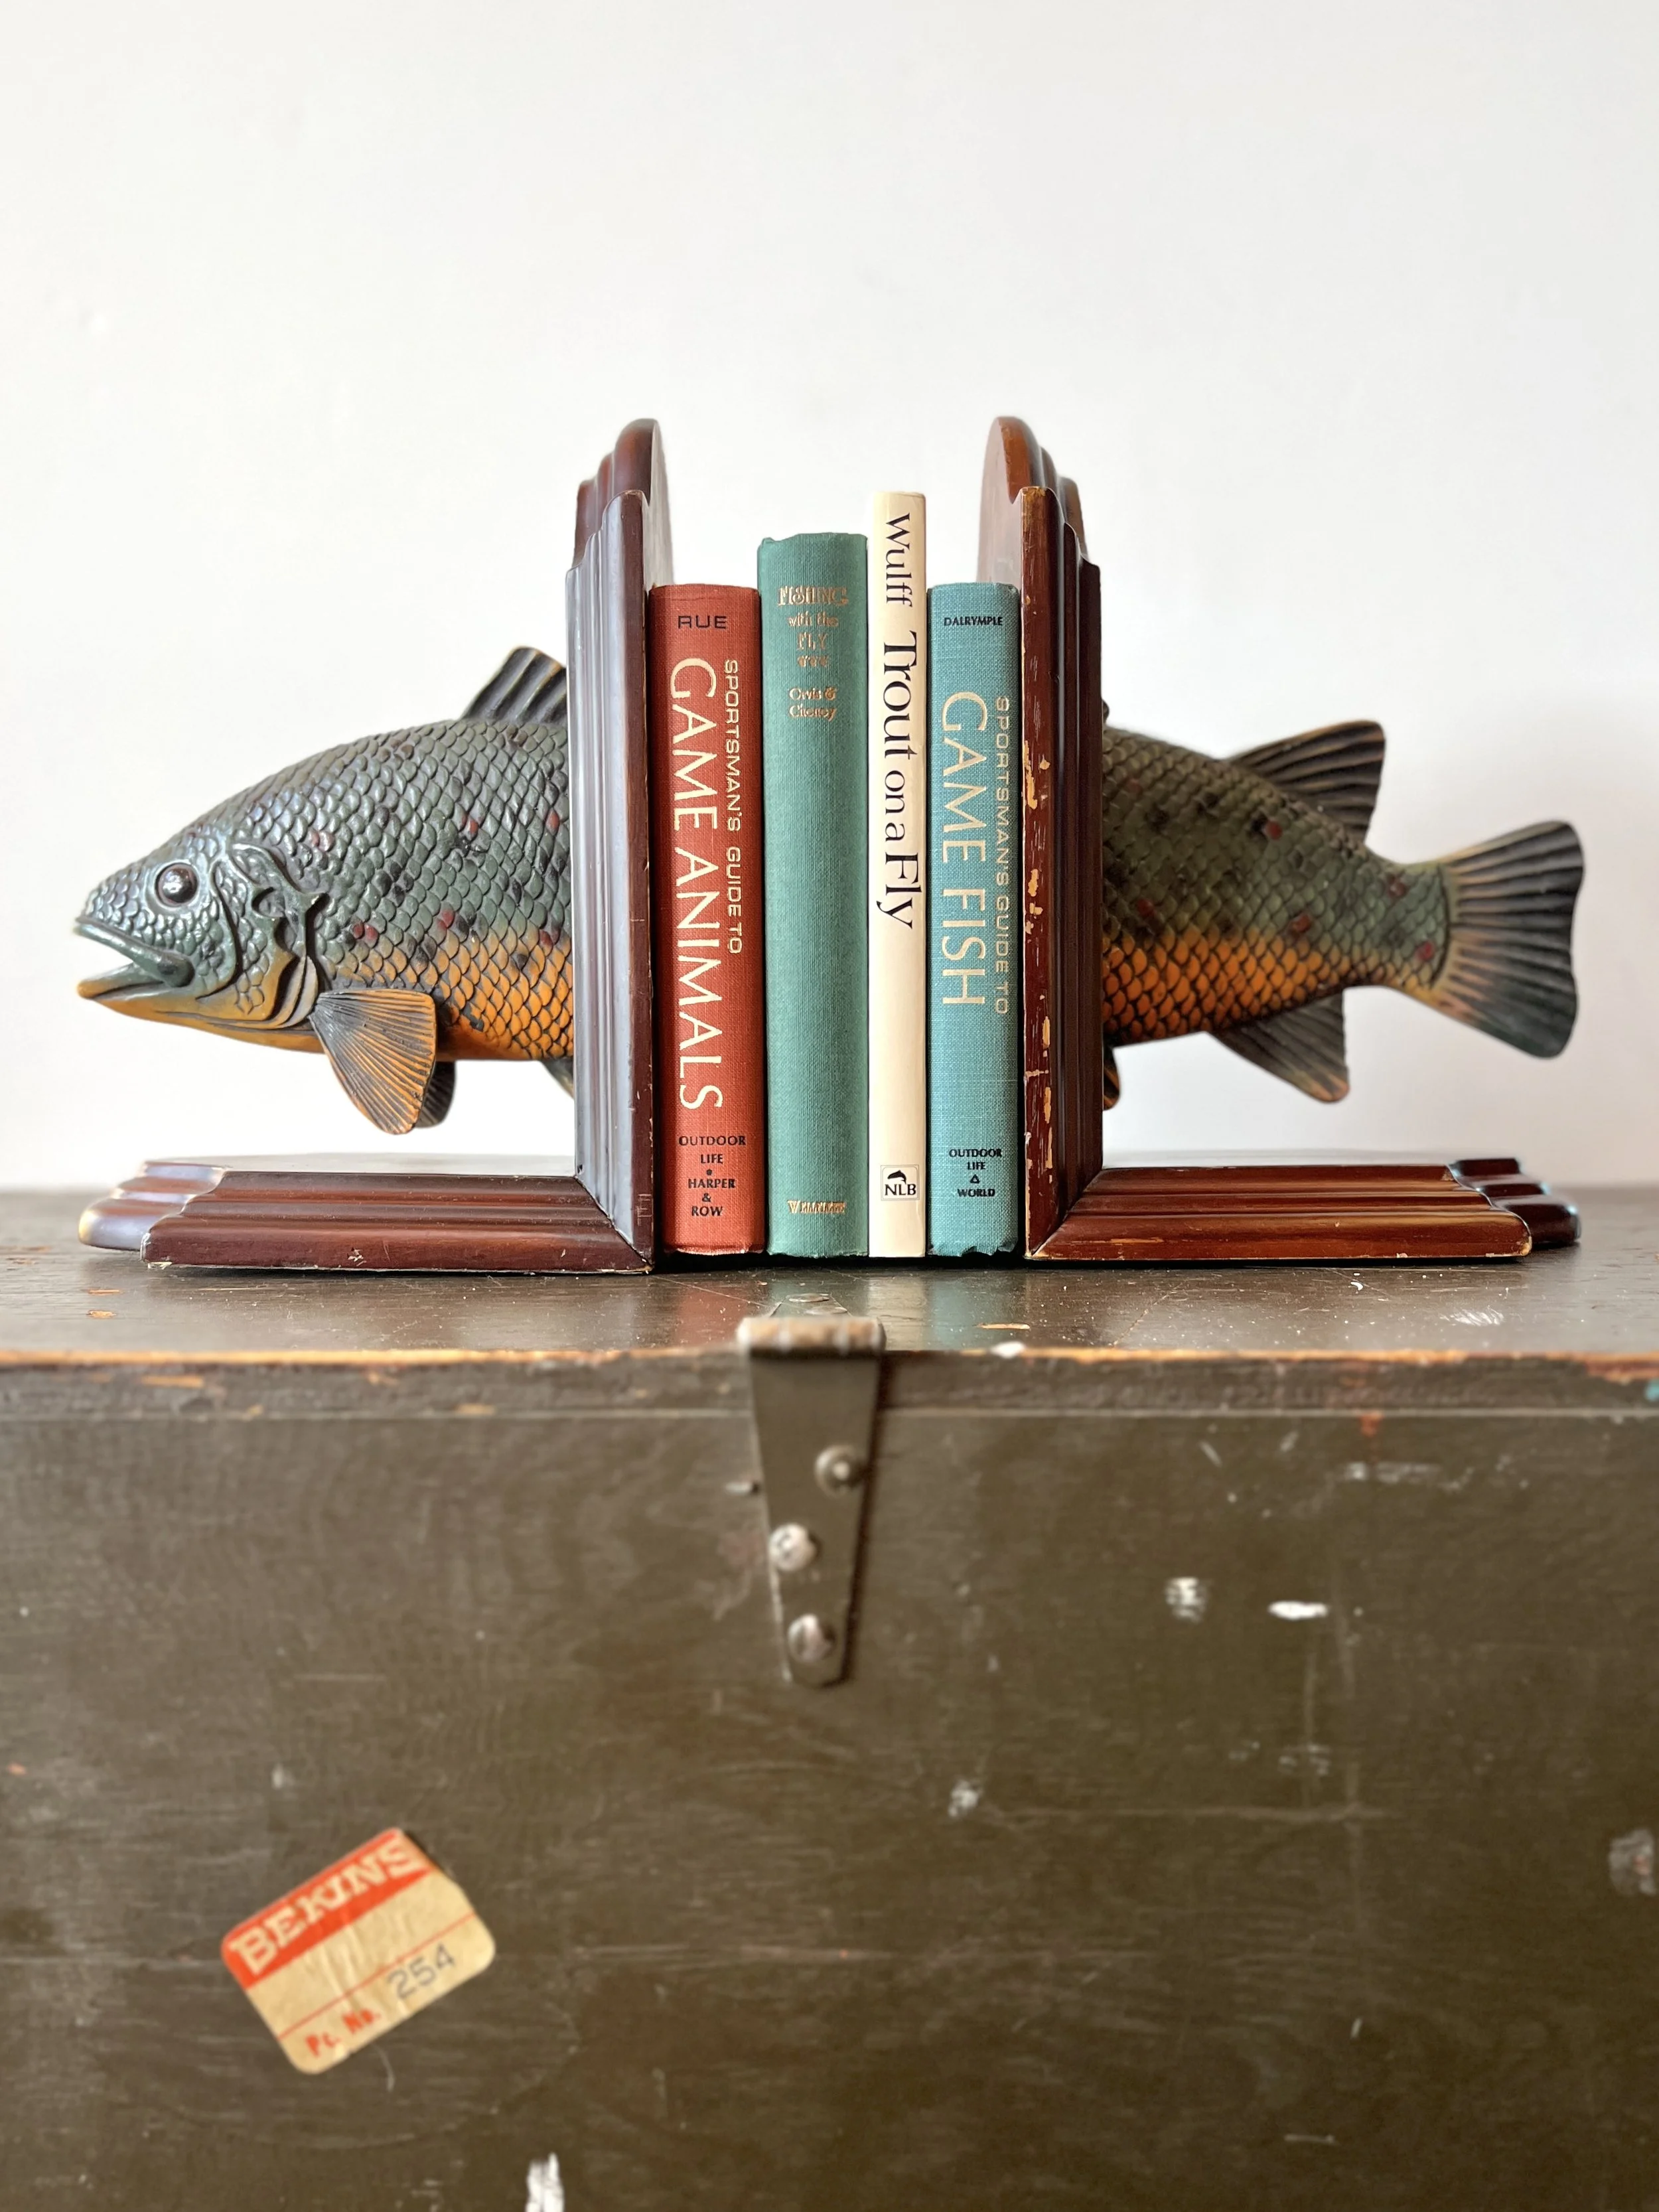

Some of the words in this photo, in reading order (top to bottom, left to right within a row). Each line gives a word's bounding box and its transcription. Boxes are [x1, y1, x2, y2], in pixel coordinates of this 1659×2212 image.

[885, 512, 913, 607] Wulff
[678, 615, 727, 630] RUE
[816, 611, 839, 627] the
[944, 616, 1003, 627] DALRYMPLE
[883, 630, 918, 760] Trout
[670, 658, 718, 831] GAME
[724, 659, 742, 832] SPORTSMAN'S
[884, 770, 905, 814] on
[942, 691, 988, 863] GAME
[995, 697, 1009, 885] SPORTSMAN'S
[885, 824, 905, 842] a
[725, 846, 742, 917] GUIDE
[876, 851, 922, 929] Fly
[727, 921, 743, 954] TO
[941, 888, 987, 1004] FISH
[995, 896, 1009, 973] GUIDE
[674, 846, 724, 1110] ANIMALS
[995, 983, 1009, 1014] TO
[678, 1136, 747, 1146] OUTDOOR
[949, 1148, 1003, 1158] OUTDOOR
[700, 1153, 724, 1165] LIFE
[967, 1161, 986, 1170] LIFE
[687, 1178, 736, 1189] HARPER
[701, 1193, 712, 1203] &
[885, 1183, 916, 1196] NLB
[957, 1188, 996, 1197] WORLD
[691, 1206, 723, 1217] ROW
[228, 1837, 425, 1976] BEKINS
[387, 1943, 456, 2000] 254
